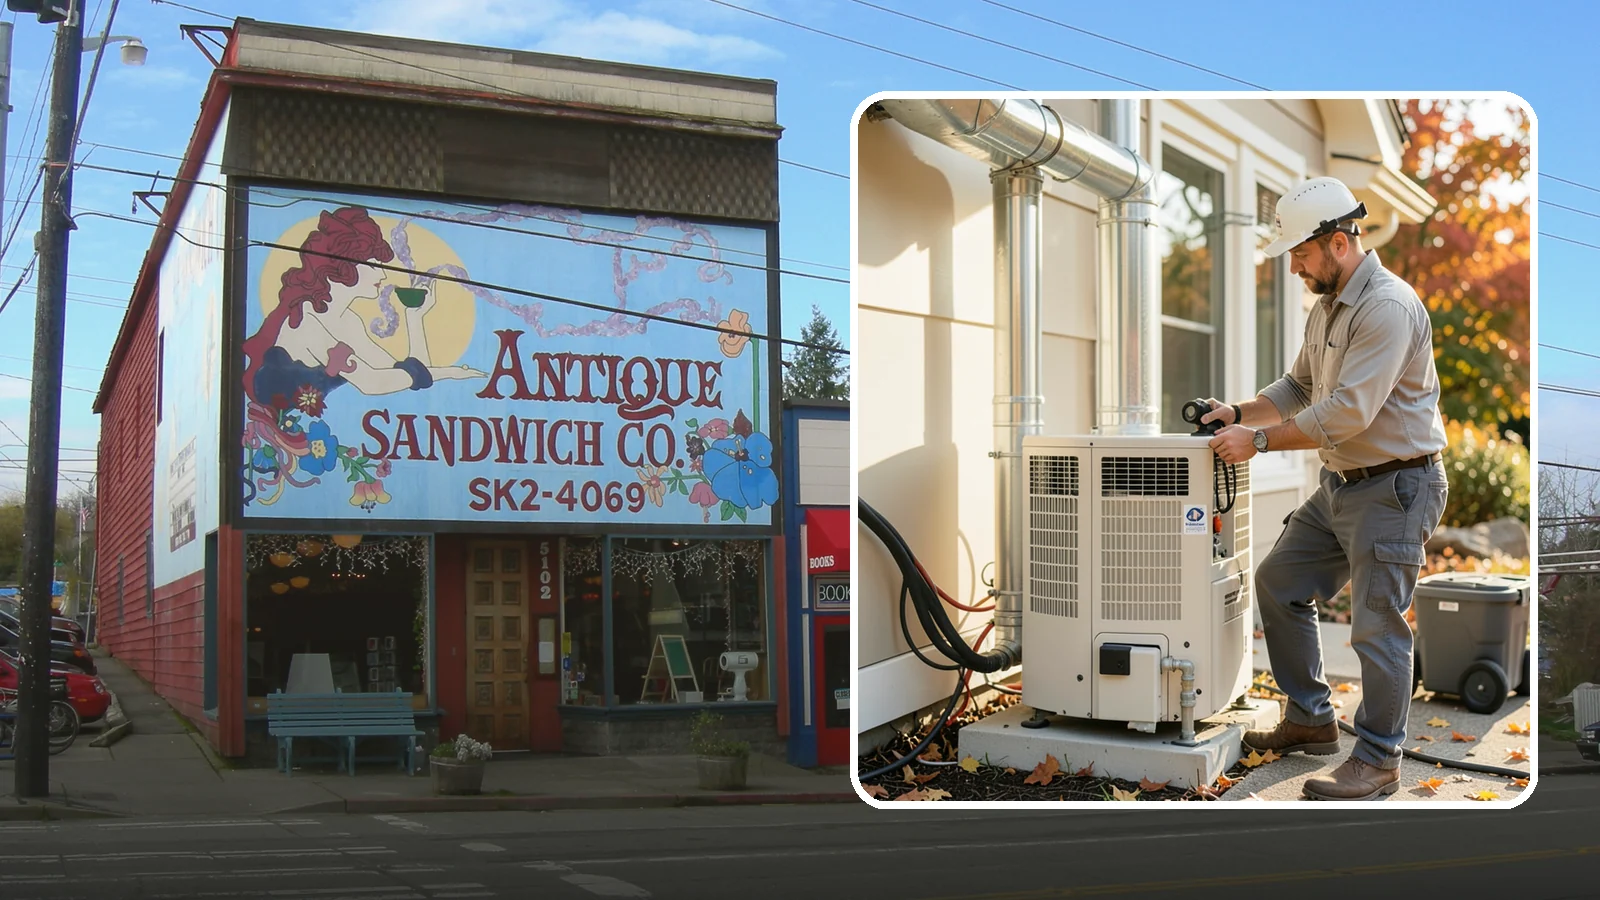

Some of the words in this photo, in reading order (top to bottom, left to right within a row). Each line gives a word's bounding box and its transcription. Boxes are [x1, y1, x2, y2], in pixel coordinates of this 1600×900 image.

[475, 329, 723, 421] ANTIQUE
[361, 408, 604, 467] SANDWICH
[617, 421, 685, 469] CO.
[468, 477, 645, 513] SK2-4069
[539, 542, 552, 599] 5102
[809, 555, 835, 569] BOOKS
